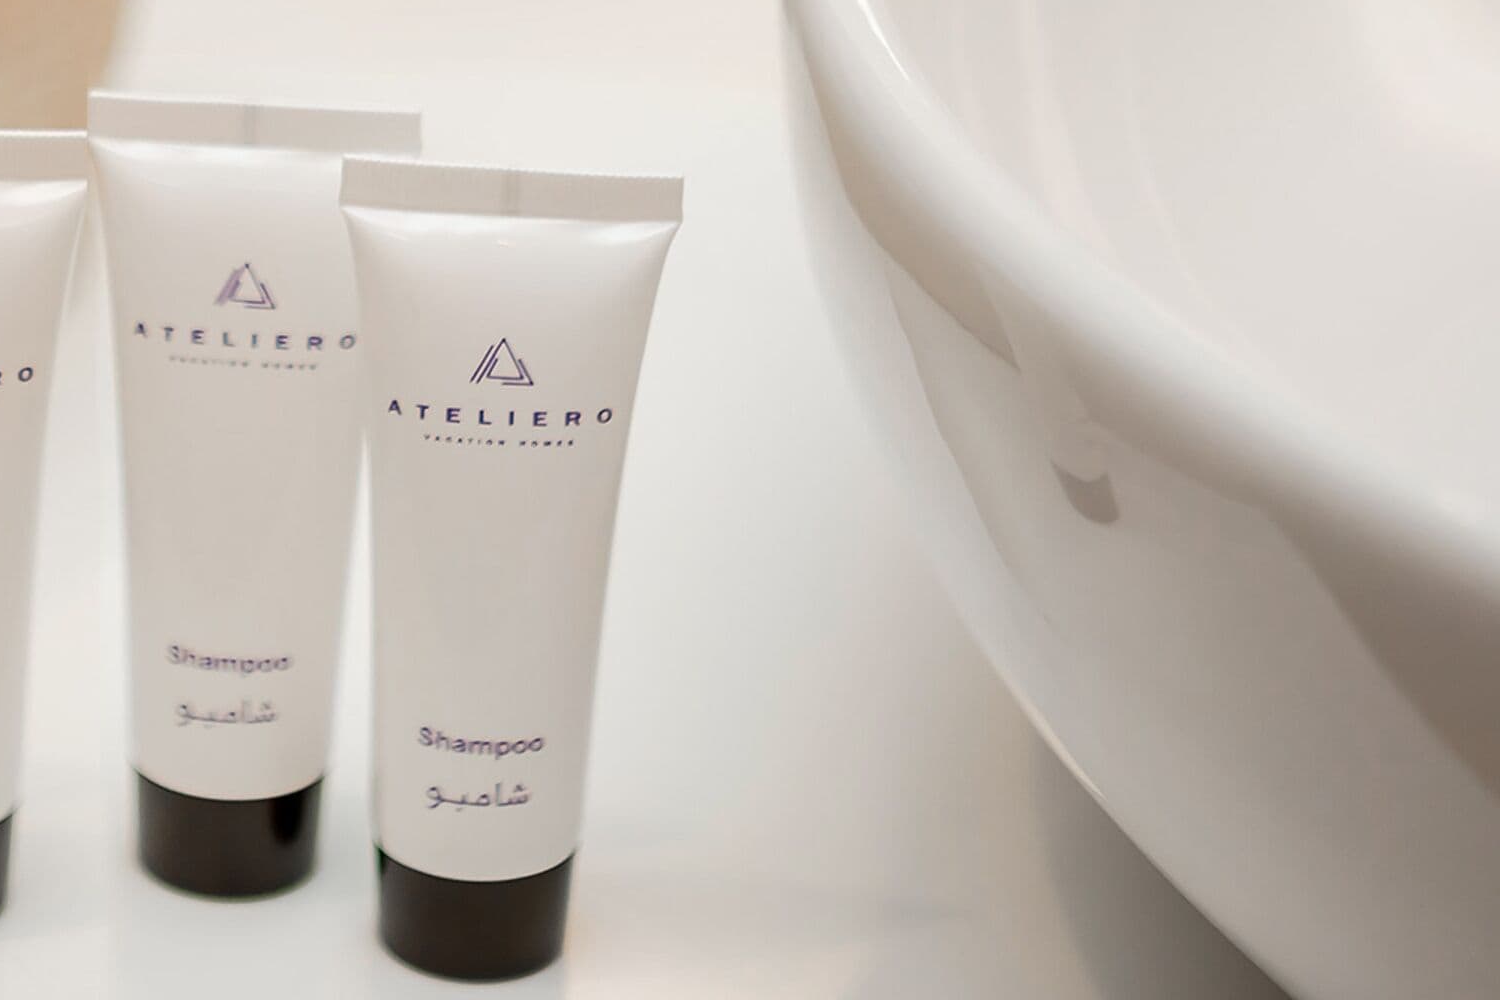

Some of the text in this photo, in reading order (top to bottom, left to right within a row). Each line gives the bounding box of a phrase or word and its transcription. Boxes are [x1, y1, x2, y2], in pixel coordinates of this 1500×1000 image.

[134, 322, 356, 351] ATELIERO
[388, 399, 613, 427] ATELIERO
[168, 645, 294, 677] Shampoo
[177, 699, 276, 728] شامبو
[419, 726, 545, 760] Shampoo
[426, 782, 530, 817] شامبو
